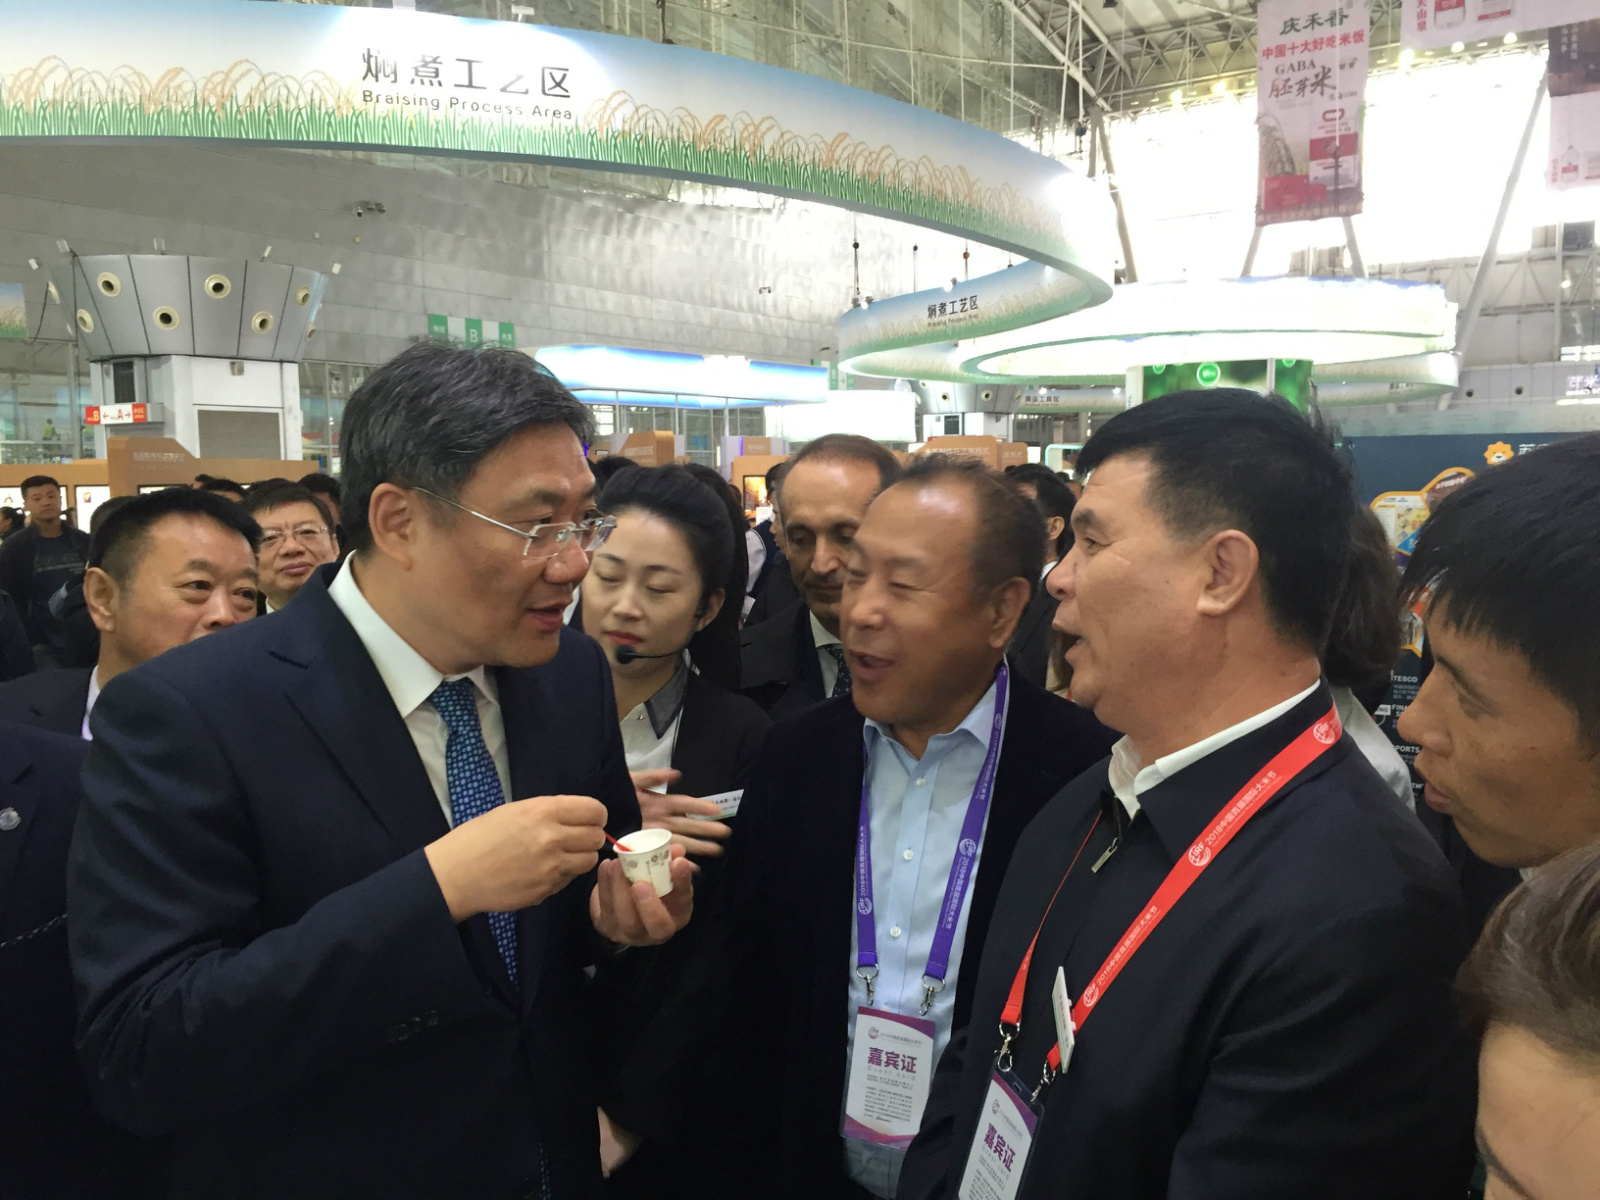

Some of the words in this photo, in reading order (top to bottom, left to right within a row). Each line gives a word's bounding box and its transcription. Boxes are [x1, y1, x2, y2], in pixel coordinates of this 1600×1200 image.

[1279, 8, 1350, 35] 庆禾香
[1275, 59, 1316, 75] GABA
[1268, 65, 1337, 98] 胚芽米
[362, 90, 440, 111] Braising
[449, 97, 523, 116] Process
[532, 105, 572, 120] Area
[927, 295, 979, 319] 焖煮工艺区
[469, 328, 478, 343] B
[117, 408, 124, 420] A
[1394, 745, 1420, 753] PORTS
[1192, 841, 1207, 857] IRF
[867, 1046, 918, 1074] 嘉宾证
[984, 1123, 1016, 1172] 嘉宾证
